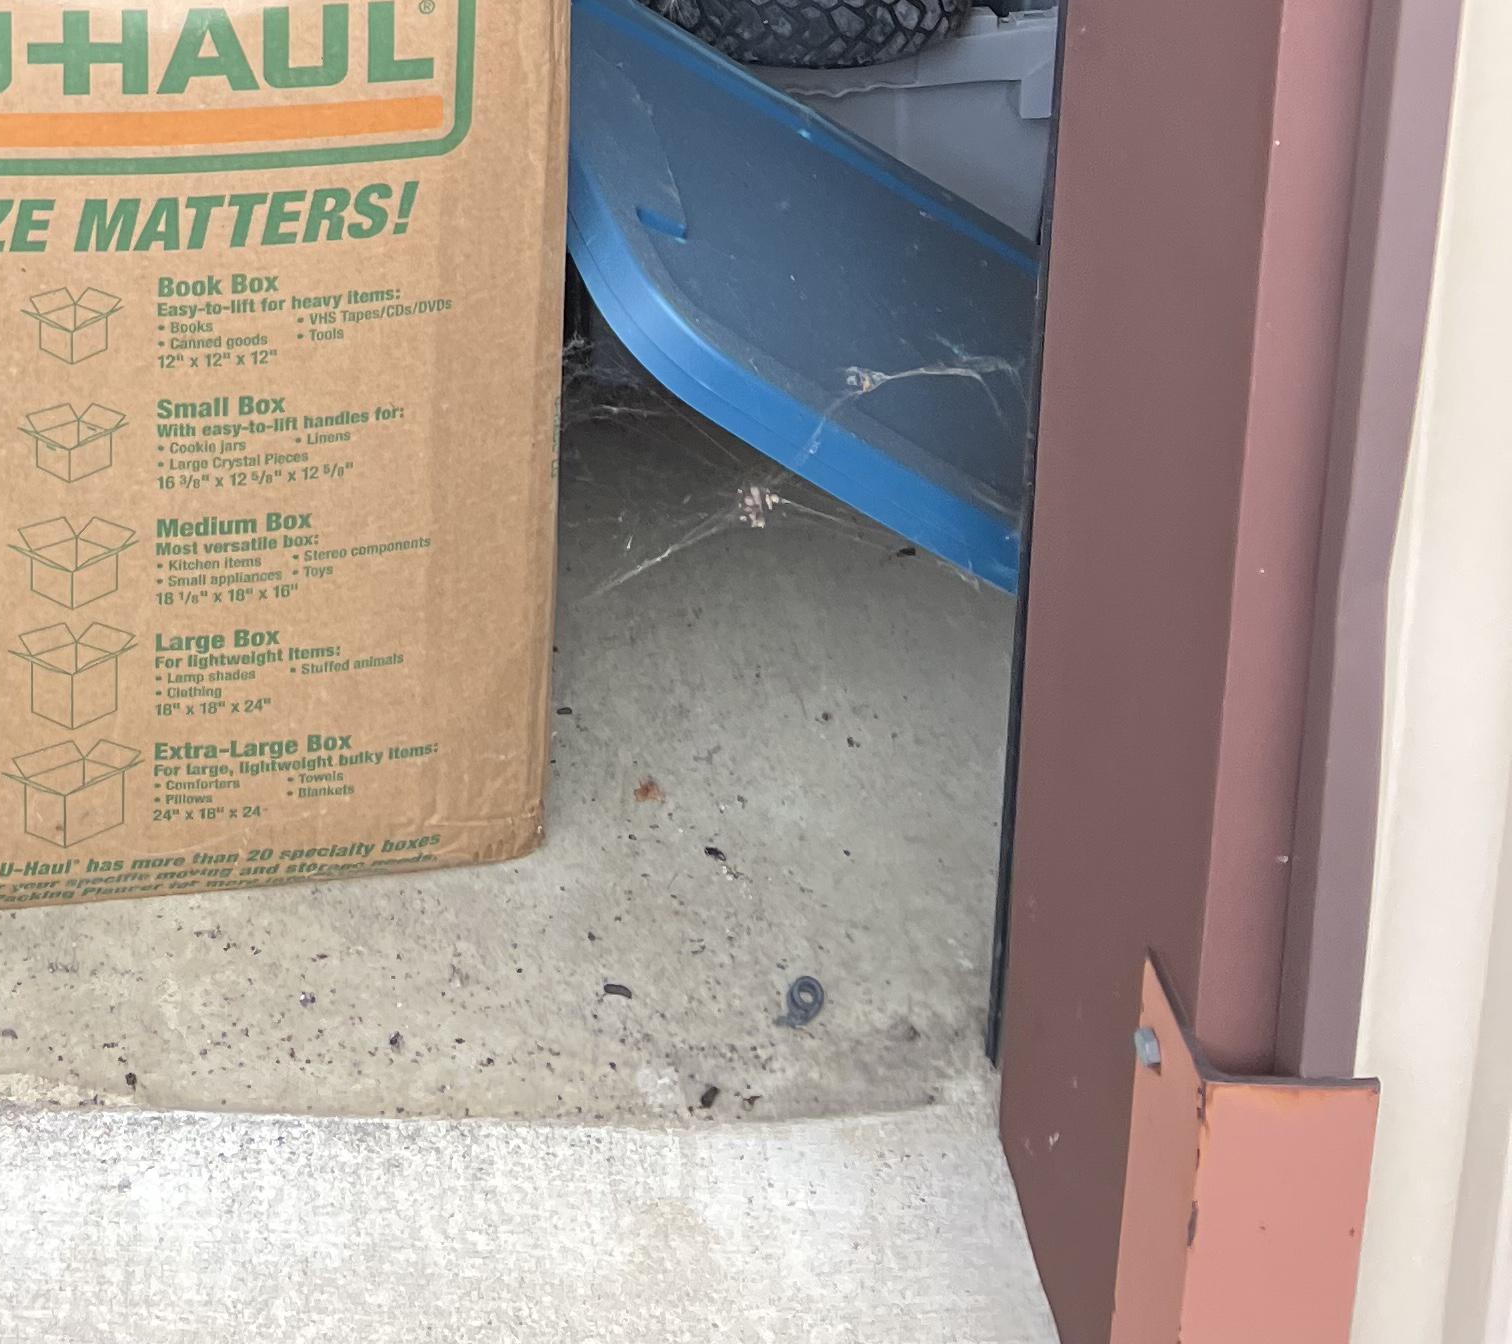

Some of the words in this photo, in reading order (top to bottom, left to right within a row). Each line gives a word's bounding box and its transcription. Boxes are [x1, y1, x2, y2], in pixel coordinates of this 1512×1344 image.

[73, 180, 420, 254] MATTERS!
[157, 275, 222, 298] Book
[231, 273, 279, 294] Box
[157, 300, 256, 320] Easy-to-lift
[261, 298, 285, 313] for
[291, 293, 343, 311] heavy
[347, 288, 401, 305] items:
[169, 320, 213, 334] Books
[309, 311, 337, 326] VHS
[170, 336, 222, 350] Canned
[226, 333, 268, 350] goods
[309, 327, 344, 342] Tools
[157, 397, 229, 419] Small
[238, 394, 286, 416] Box
[157, 422, 196, 438] With
[202, 416, 298, 437] easy-to-lift
[303, 410, 369, 430] handles
[375, 404, 405, 421] for:
[170, 441, 216, 454] Cookie
[220, 439, 246, 454] jars
[307, 430, 351, 445] Linens
[169, 456, 209, 472] Large
[212, 453, 261, 471] Crystal
[264, 450, 309, 466] Pieces
[156, 515, 257, 538] Medium
[266, 512, 312, 532] Box
[156, 540, 198, 556] Most
[203, 536, 277, 555] versatile
[283, 532, 319, 549] box:
[304, 547, 347, 562] Stereo
[350, 536, 431, 559] components
[168, 557, 220, 572] Kitchen
[224, 555, 262, 569] items
[304, 564, 334, 579] Toys
[168, 574, 206, 588] Small
[210, 570, 282, 588] appliances
[155, 632, 225, 657] Large
[234, 629, 280, 649] Box
[155, 656, 183, 671] For
[188, 648, 284, 669] lightweight
[289, 644, 341, 662] items:
[301, 659, 350, 675] Stuffed
[353, 652, 404, 671] animals
[167, 672, 204, 686] Lamp
[208, 669, 256, 683] shades
[167, 685, 222, 700] Clothing
[154, 737, 298, 761] Extra-Large
[306, 733, 352, 753] Box
[154, 763, 181, 777] For
[186, 760, 234, 778] large,
[239, 754, 334, 776] lightweight
[339, 749, 384, 767] bulky
[388, 741, 439, 760] items:
[166, 777, 240, 791] Comforters
[299, 771, 344, 785] Towels
[166, 793, 213, 806] Pillows
[299, 783, 355, 798] Blankets
[86, 857, 124, 873] has
[131, 856, 186, 870] more
[192, 852, 239, 866] than
[247, 848, 274, 862] 20
[279, 842, 375, 860] specialty
[381, 833, 441, 853] boxes
